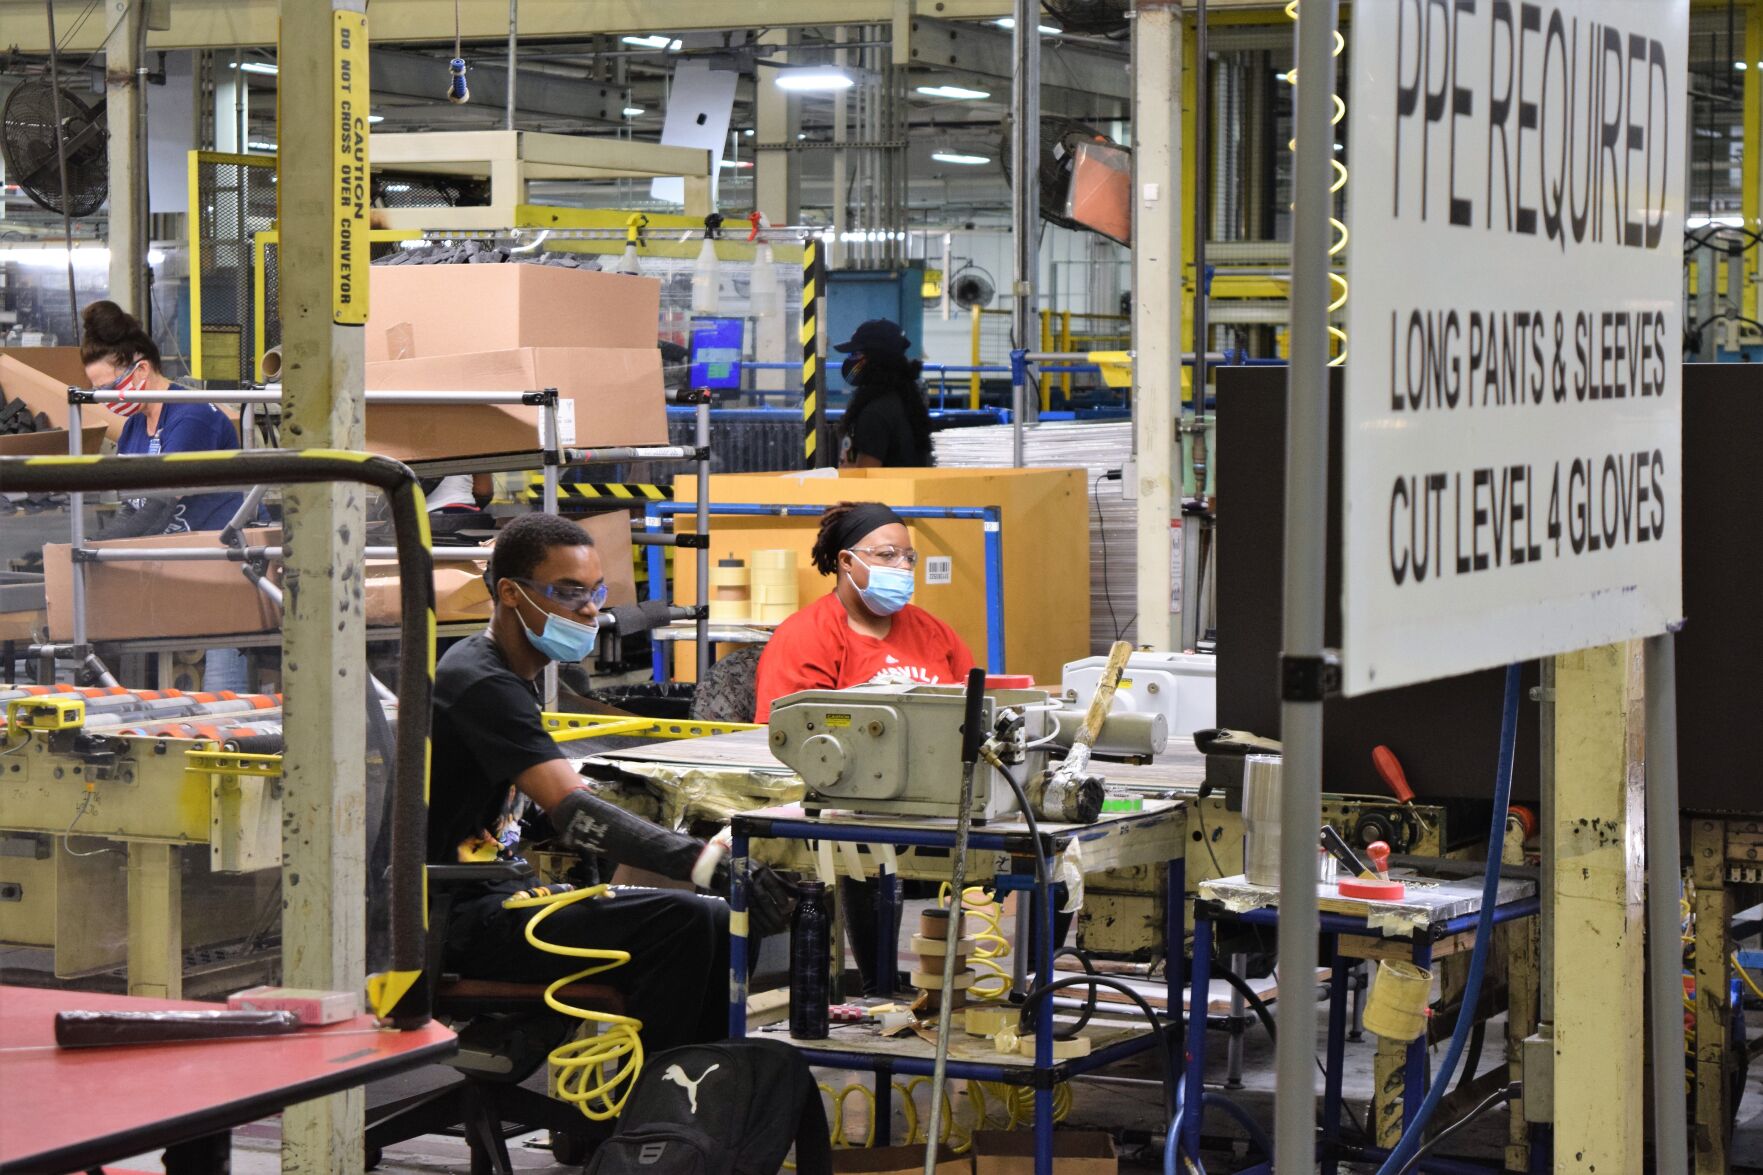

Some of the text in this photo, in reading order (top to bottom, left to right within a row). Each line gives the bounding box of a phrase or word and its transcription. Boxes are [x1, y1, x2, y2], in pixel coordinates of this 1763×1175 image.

[340, 28, 352, 304] DO NOT CROSS OVER CONVEYOR
[354, 117, 364, 219] CAUTION
[1393, 0, 1669, 255] PPE REQUIRED
[1391, 308, 1666, 411] LONG PANTS & SLEEVES
[1389, 448, 1665, 587] CUT LEVEL 4 GLOVES
